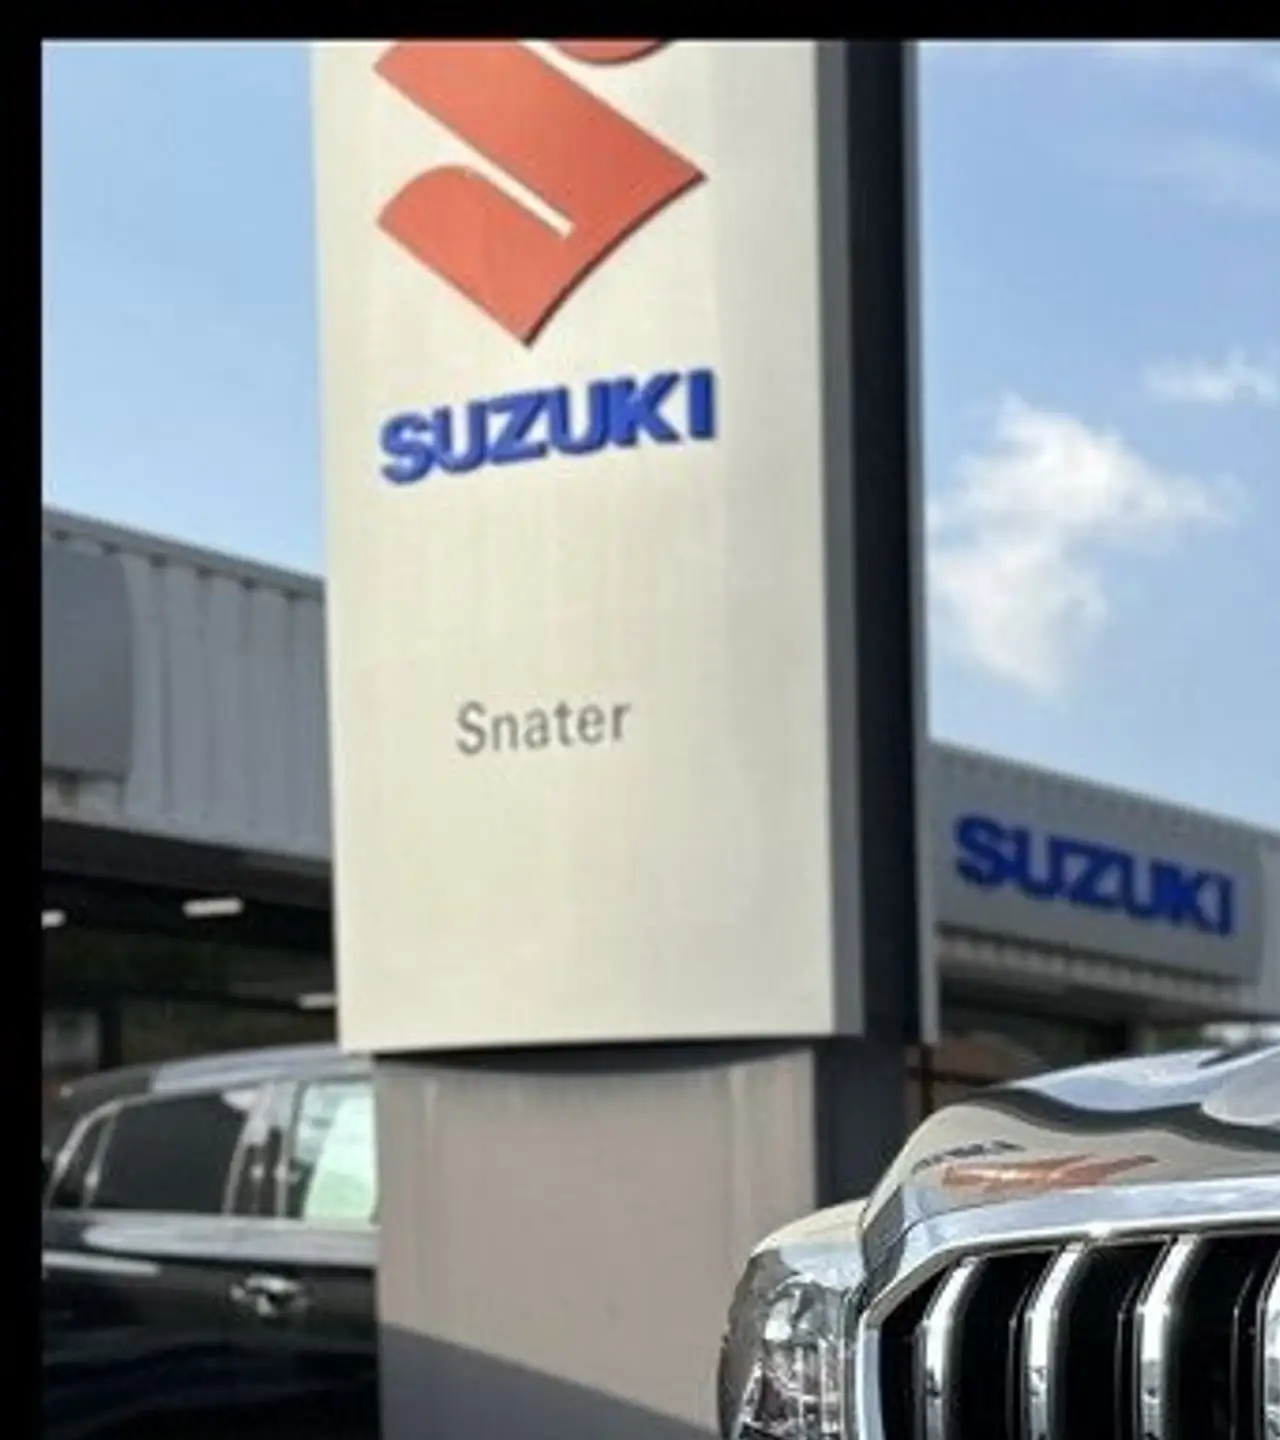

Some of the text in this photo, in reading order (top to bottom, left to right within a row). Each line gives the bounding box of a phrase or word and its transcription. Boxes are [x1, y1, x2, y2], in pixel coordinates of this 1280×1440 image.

[380, 369, 717, 485] SUZUKI
[455, 700, 630, 756] Snater
[955, 815, 1237, 938] SUZUKI
